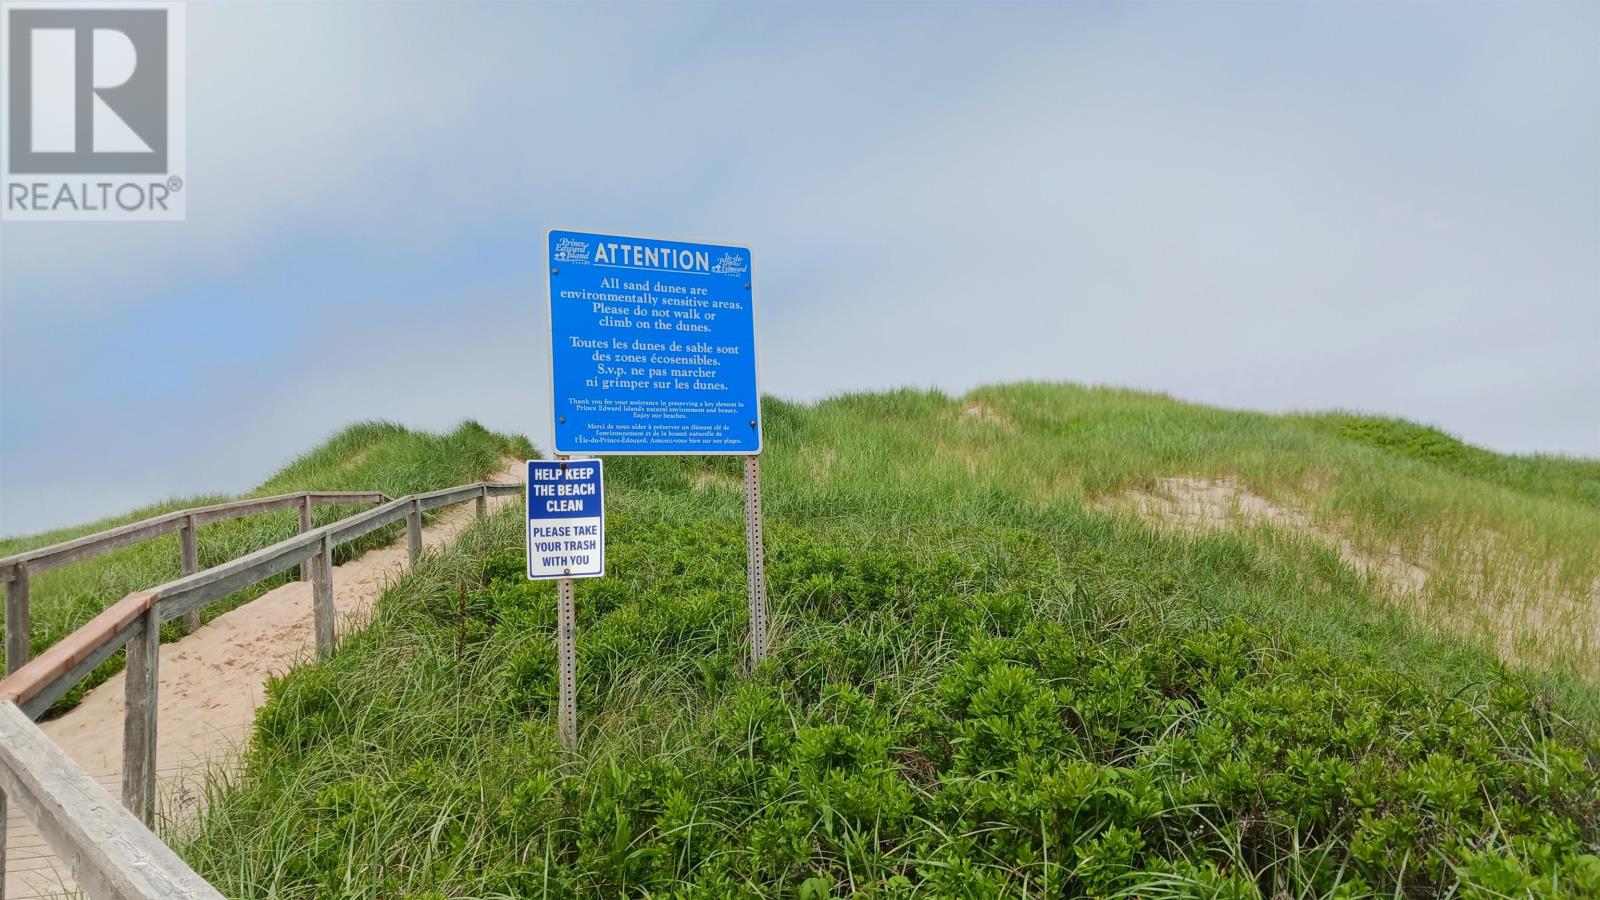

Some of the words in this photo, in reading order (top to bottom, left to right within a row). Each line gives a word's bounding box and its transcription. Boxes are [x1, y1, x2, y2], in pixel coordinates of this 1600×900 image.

[560, 238, 589, 247] Prince
[594, 242, 709, 271] ATTENTION
[600, 277, 619, 289] All
[624, 280, 649, 291] sand
[654, 282, 686, 294] dunes
[690, 286, 707, 295] are
[560, 289, 658, 306] environmentally
[662, 296, 709, 308] sensitive
[712, 300, 743, 310] areas.
[593, 303, 629, 315] Please
[634, 306, 647, 316] do
[652, 309, 669, 318] not
[674, 309, 700, 319] walk
[704, 312, 715, 320] or
[599, 316, 632, 328] climb
[636, 320, 650, 329] on
[655, 321, 672, 330] the
[676, 321, 711, 332] dunes.
[569, 336, 608, 348] Toutes
[613, 338, 628, 350] les
[632, 339, 665, 351] dunes
[669, 341, 682, 352] de
[686, 342, 713, 353] sable
[717, 344, 738, 354] sont
[592, 351, 611, 361] des
[615, 354, 646, 363] zones
[651, 353, 720, 366] écosensibles.
[598, 364, 627, 376] S.v.p.
[631, 367, 644, 376] ne
[649, 368, 667, 378] pas
[672, 366, 716, 378] marcher
[586, 376, 598, 386] ni
[602, 377, 649, 390] grimper
[654, 380, 671, 388] sur
[675, 378, 689, 389] les
[693, 379, 728, 391] dunes.
[535, 469, 562, 480] HELP
[565, 468, 593, 480] KEEP
[534, 485, 555, 496] THE
[558, 483, 595, 495] BEACH
[546, 500, 583, 512] CLEAN
[534, 527, 570, 537] PLEASE
[573, 525, 597, 536] TAKE
[535, 542, 561, 552] YOUR
[564, 540, 596, 551] TRASH
[543, 557, 567, 566] WITH
[570, 555, 589, 565] YOU
